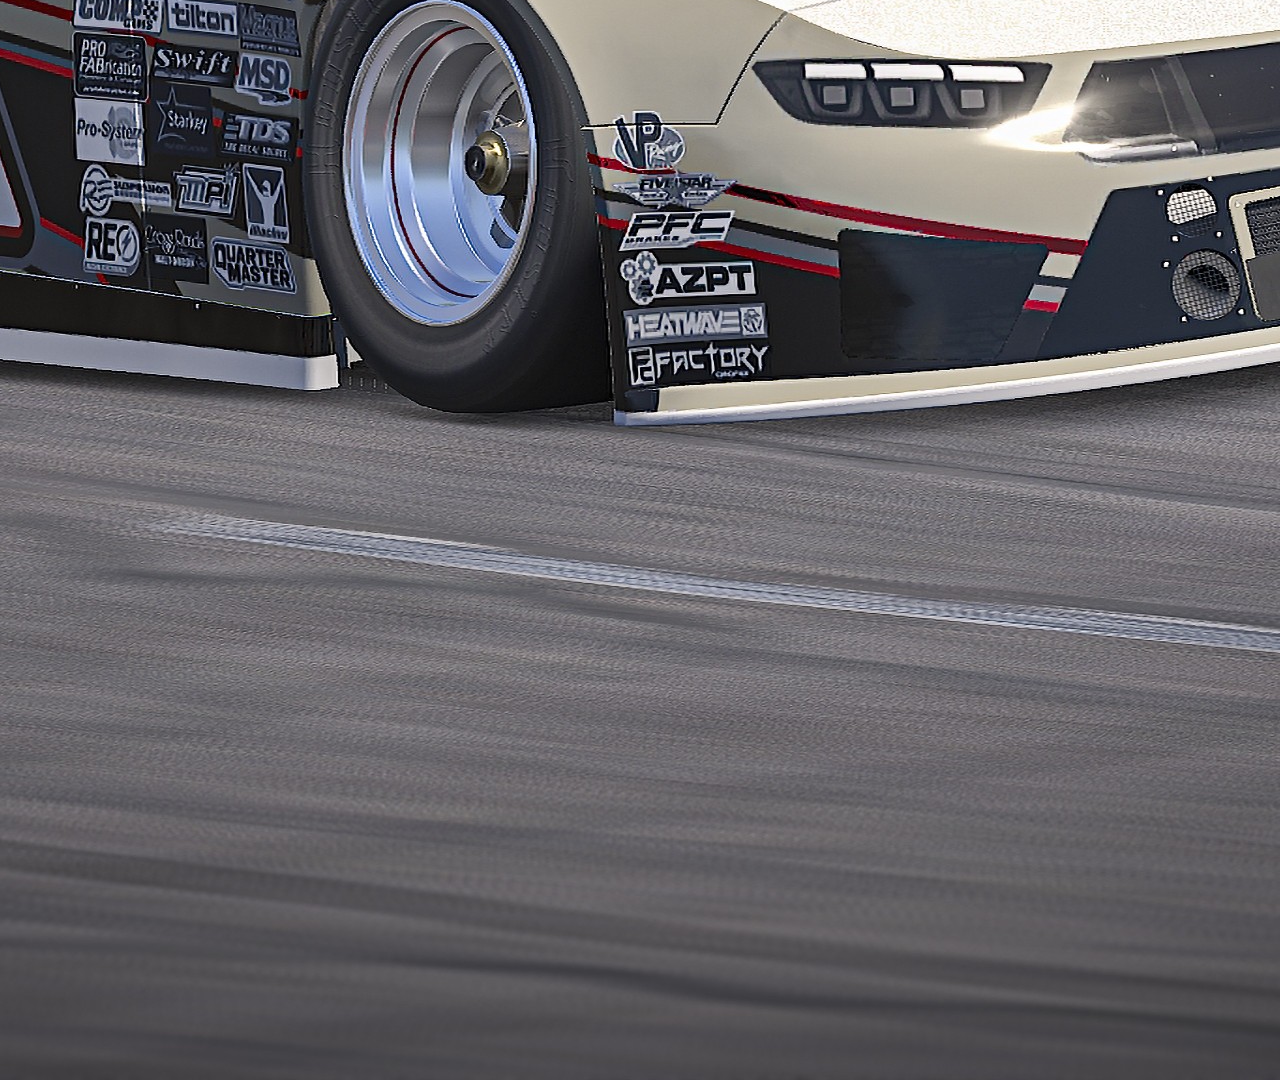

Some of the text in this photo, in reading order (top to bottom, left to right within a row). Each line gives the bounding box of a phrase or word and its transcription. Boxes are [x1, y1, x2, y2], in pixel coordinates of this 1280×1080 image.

[171, 2, 236, 34] tilton
[81, 38, 107, 58] PRO
[238, 56, 290, 91] MSD
[615, 112, 662, 169] VP
[628, 212, 732, 238] PFC
[214, 243, 286, 271] QUARTER
[228, 262, 293, 289] MASTER
[656, 264, 753, 295] AZPT
[625, 311, 741, 341] HEATWAVE
[656, 343, 769, 379] FACTORY
